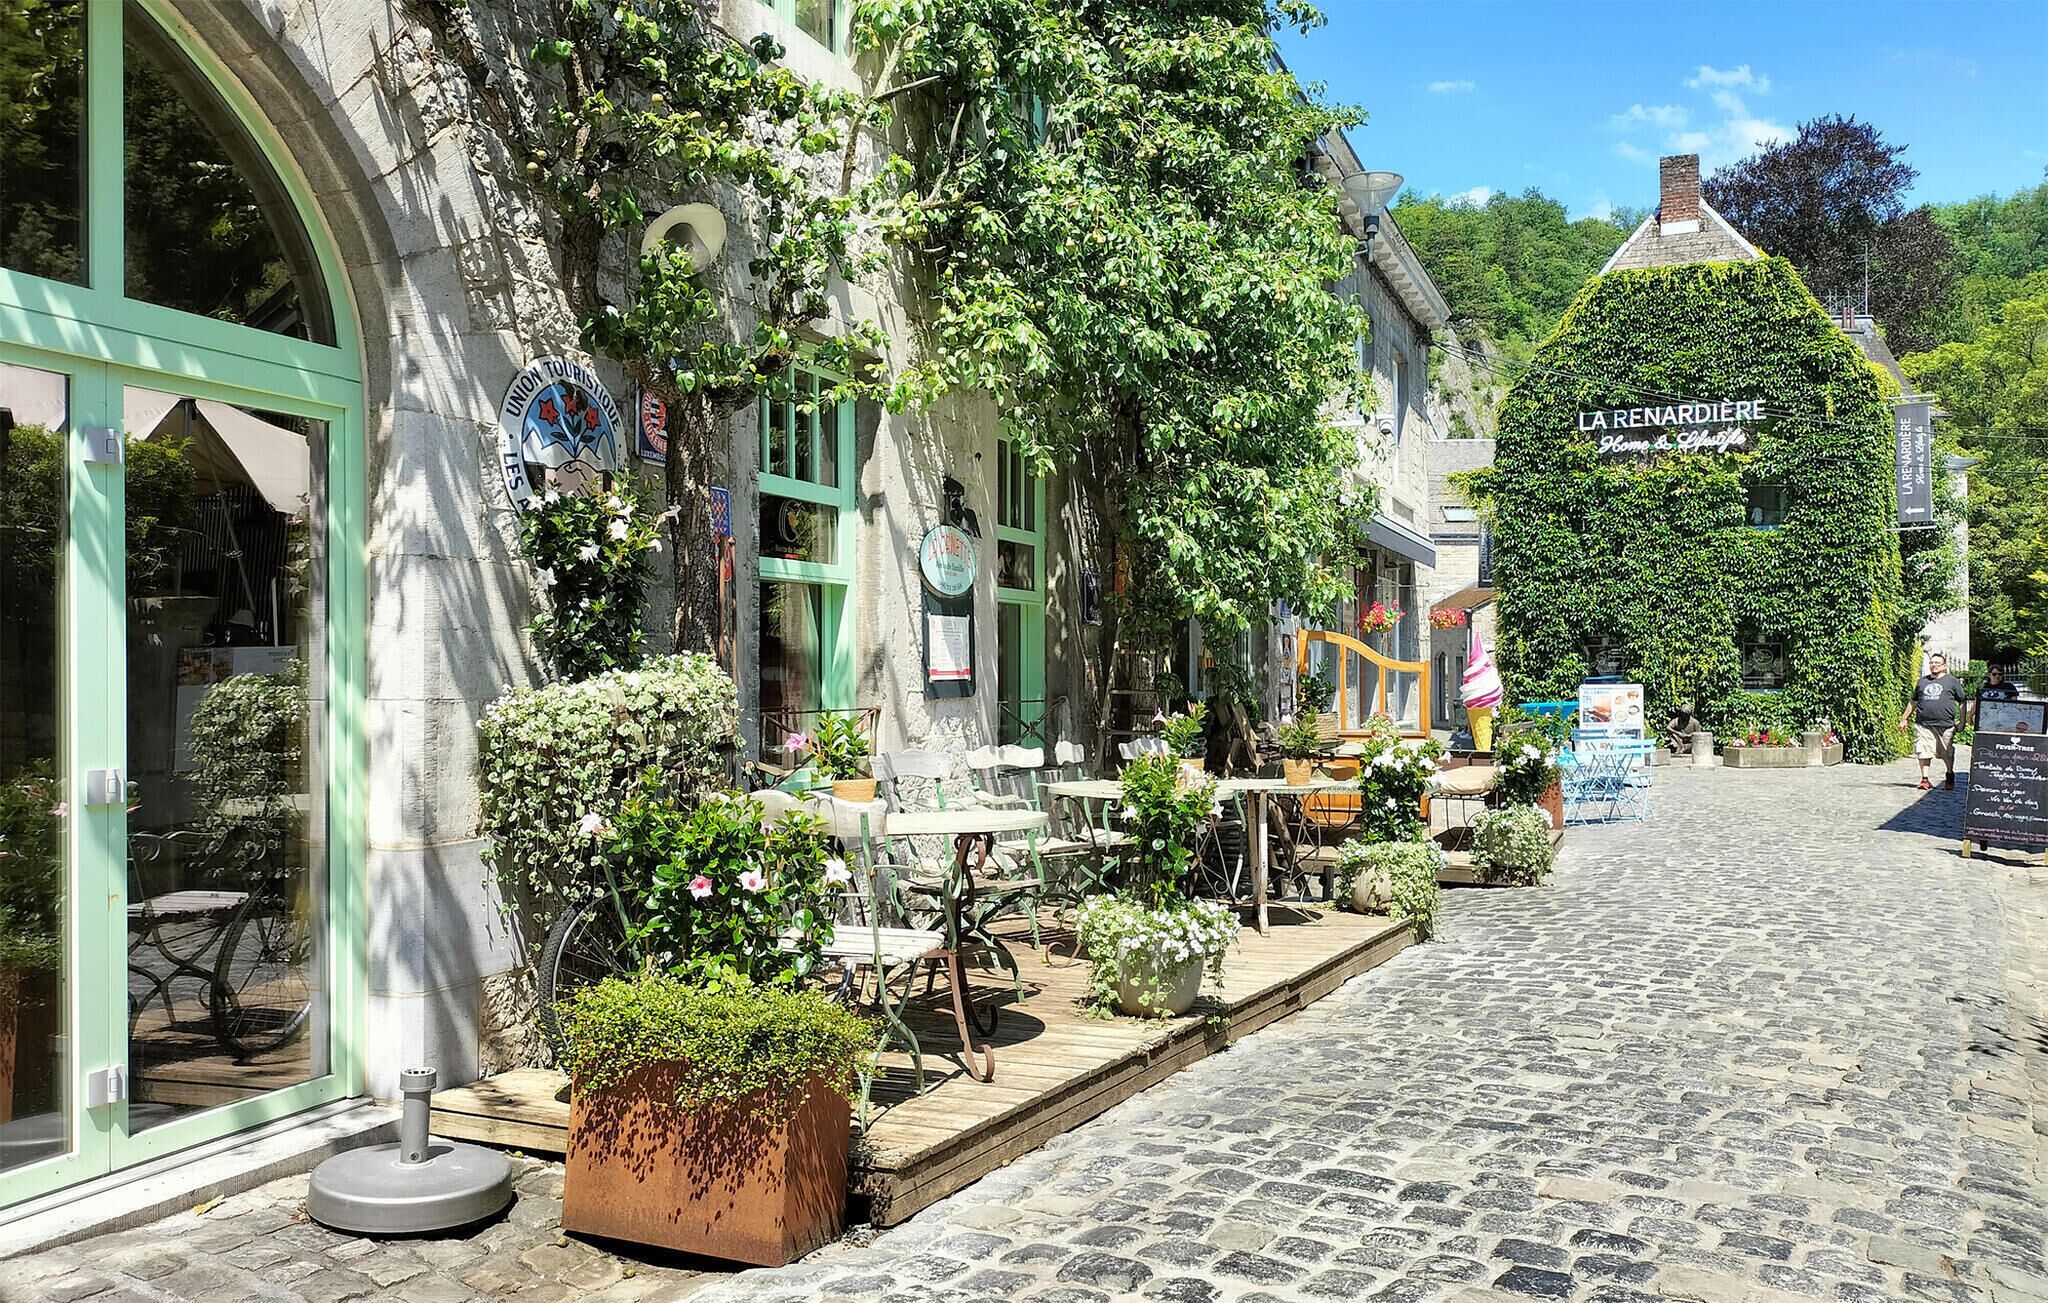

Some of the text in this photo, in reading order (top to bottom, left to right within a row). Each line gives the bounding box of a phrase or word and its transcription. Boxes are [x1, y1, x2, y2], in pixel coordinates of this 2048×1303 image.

[505, 360, 622, 432] UNION TOURISTIQUE
[1578, 397, 1768, 431] LA RENARDIÈRE
[1597, 427, 1747, 454] Home & Lifestyle
[1898, 417, 1913, 495] LA RENARDIÈRE
[503, 452, 524, 491] LES
[1995, 744, 2035, 752] FEVER-TREE
